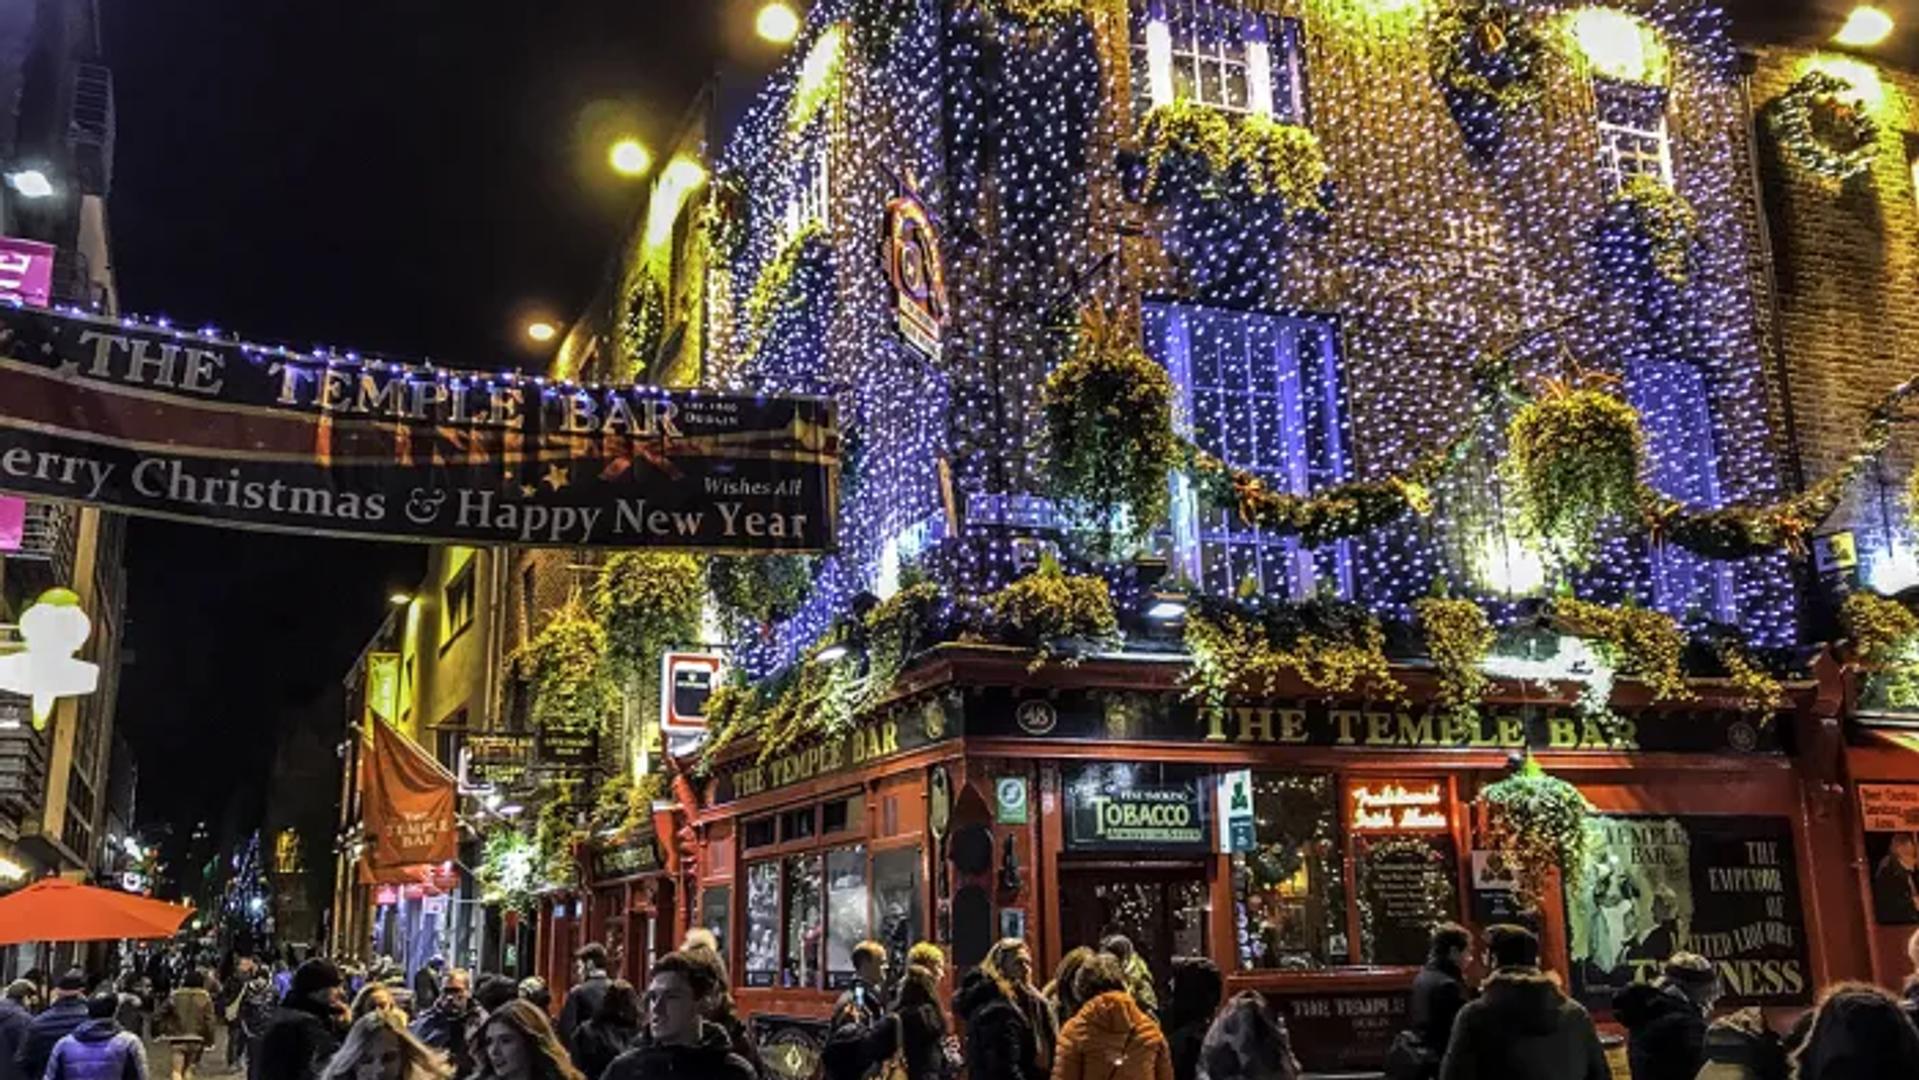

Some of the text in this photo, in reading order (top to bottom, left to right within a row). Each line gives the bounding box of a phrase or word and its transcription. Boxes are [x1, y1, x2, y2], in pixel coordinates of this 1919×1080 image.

[79, 330, 684, 438] THE TEMPLE BAR
[2, 446, 808, 543] erry Christmas & Happy New Year
[704, 477, 802, 496] Wishes All
[1198, 707, 1640, 751] THE TEMPLE BAR
[732, 720, 899, 799] THE TEMPLE BAR
[386, 819, 450, 837] TEMPLE
[1090, 795, 1190, 835] TOBACCO
[402, 833, 435, 849] BAR
[1630, 847, 1671, 865] BAR
[1745, 841, 1779, 865] THE
